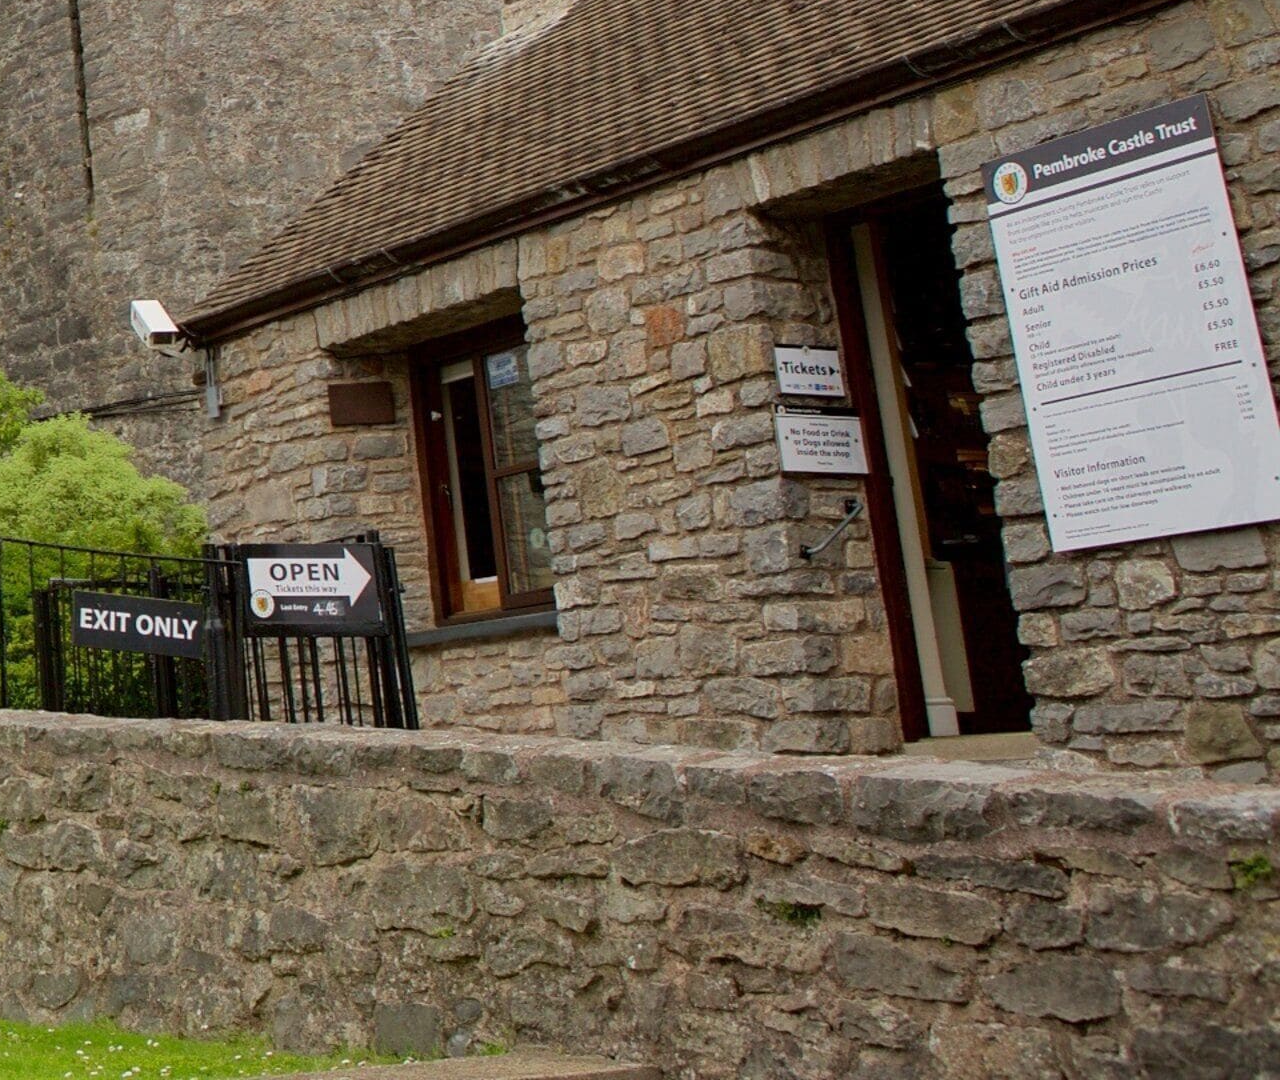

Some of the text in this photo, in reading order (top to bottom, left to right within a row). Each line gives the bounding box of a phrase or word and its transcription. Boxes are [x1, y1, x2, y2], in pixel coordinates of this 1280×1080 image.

[1033, 116, 1197, 179] Pembroke Castle Trust
[1019, 286, 1039, 300] Gift
[1042, 281, 1059, 295] Aid
[1062, 267, 1120, 289] Admission
[1122, 256, 1157, 273] Prices
[1023, 259, 1220, 316] Adult £6.60
[1026, 276, 1224, 332] Senior £5.50
[1029, 298, 1229, 352] Child £5.50
[1033, 318, 1233, 371] Registered Disabled £5.50
[782, 361, 827, 375] Tickets
[1036, 381, 1057, 392] Child
[1060, 375, 1083, 386] under
[1093, 369, 1116, 380] years
[1214, 339, 1239, 352] FREE
[803, 439, 821, 448] Dogs
[833, 450, 850, 458] shop
[1054, 455, 1146, 479] Visitor Information
[269, 563, 340, 581] OPEN
[276, 585, 303, 593] Tickets
[305, 585, 320, 593] this
[80, 608, 198, 640] EXIT ONLY
[292, 604, 308, 612] Entry
